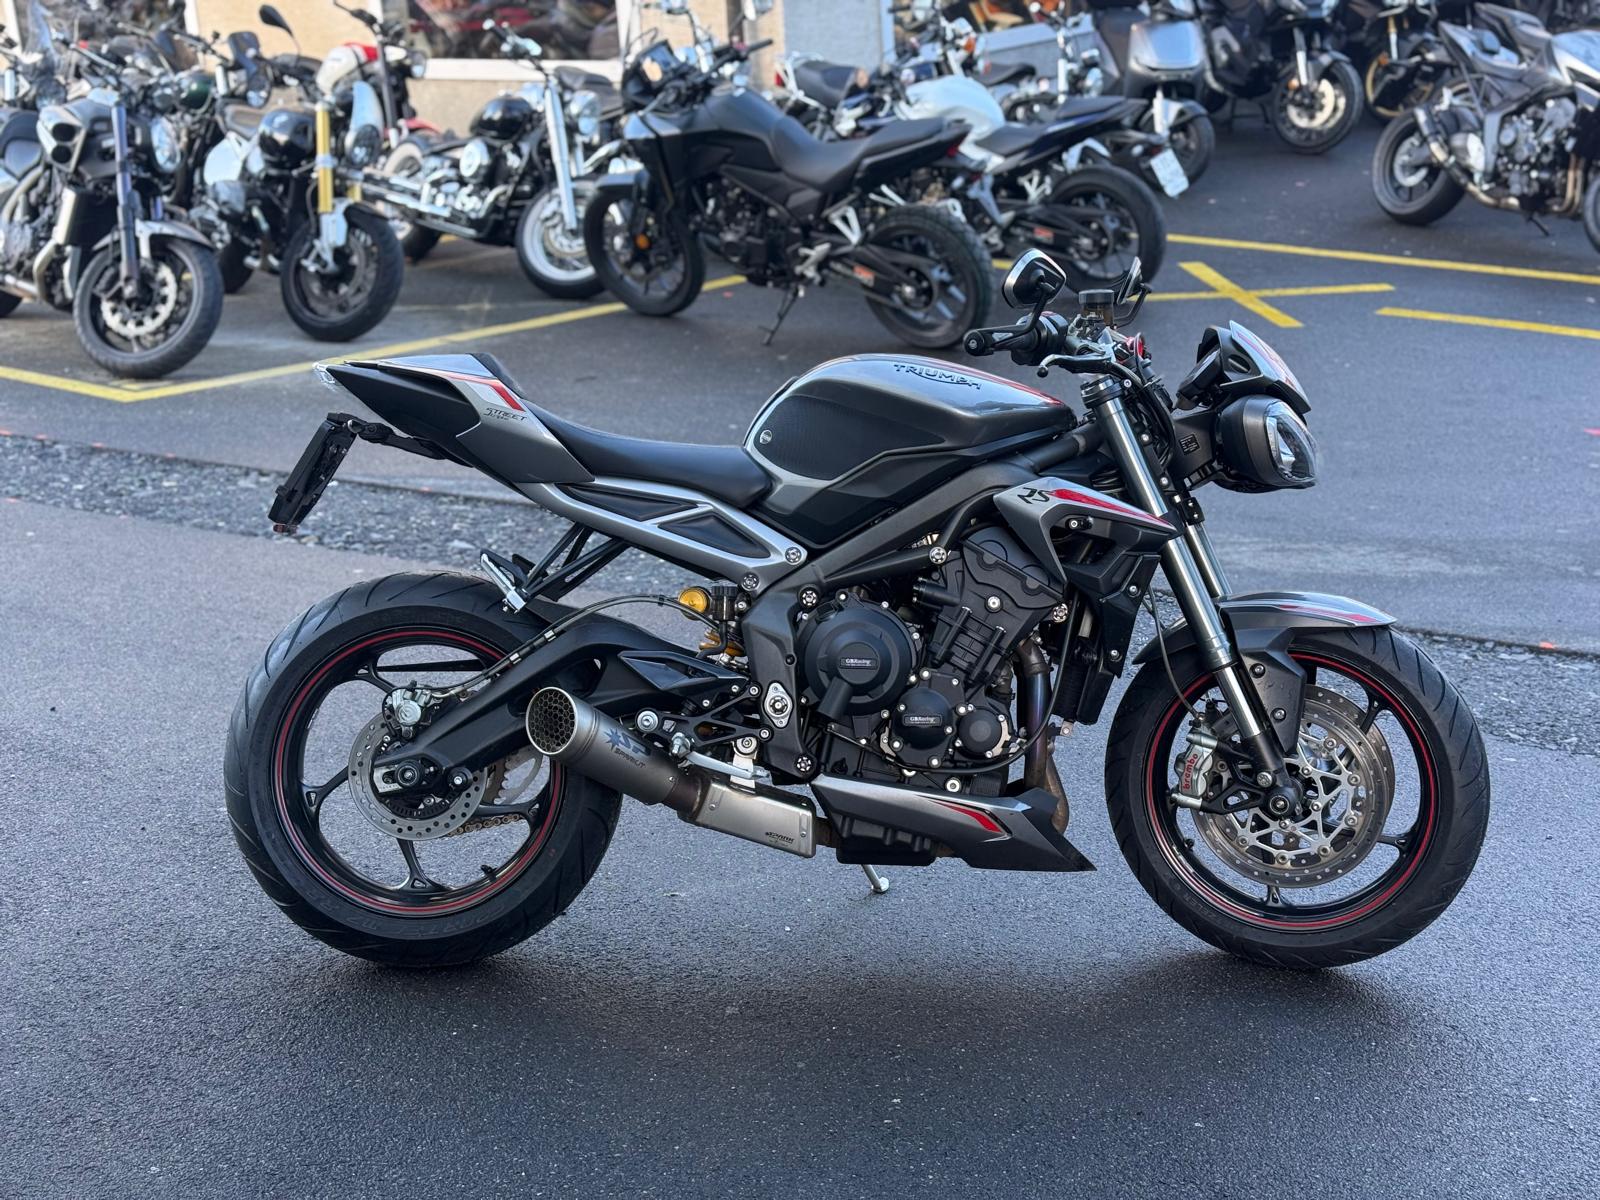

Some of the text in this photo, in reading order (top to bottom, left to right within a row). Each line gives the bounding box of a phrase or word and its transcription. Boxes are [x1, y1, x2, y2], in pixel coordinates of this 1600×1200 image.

[893, 364, 982, 390] TRIUMPH
[485, 407, 528, 421] STREET
[1183, 753, 1199, 790] brembo
